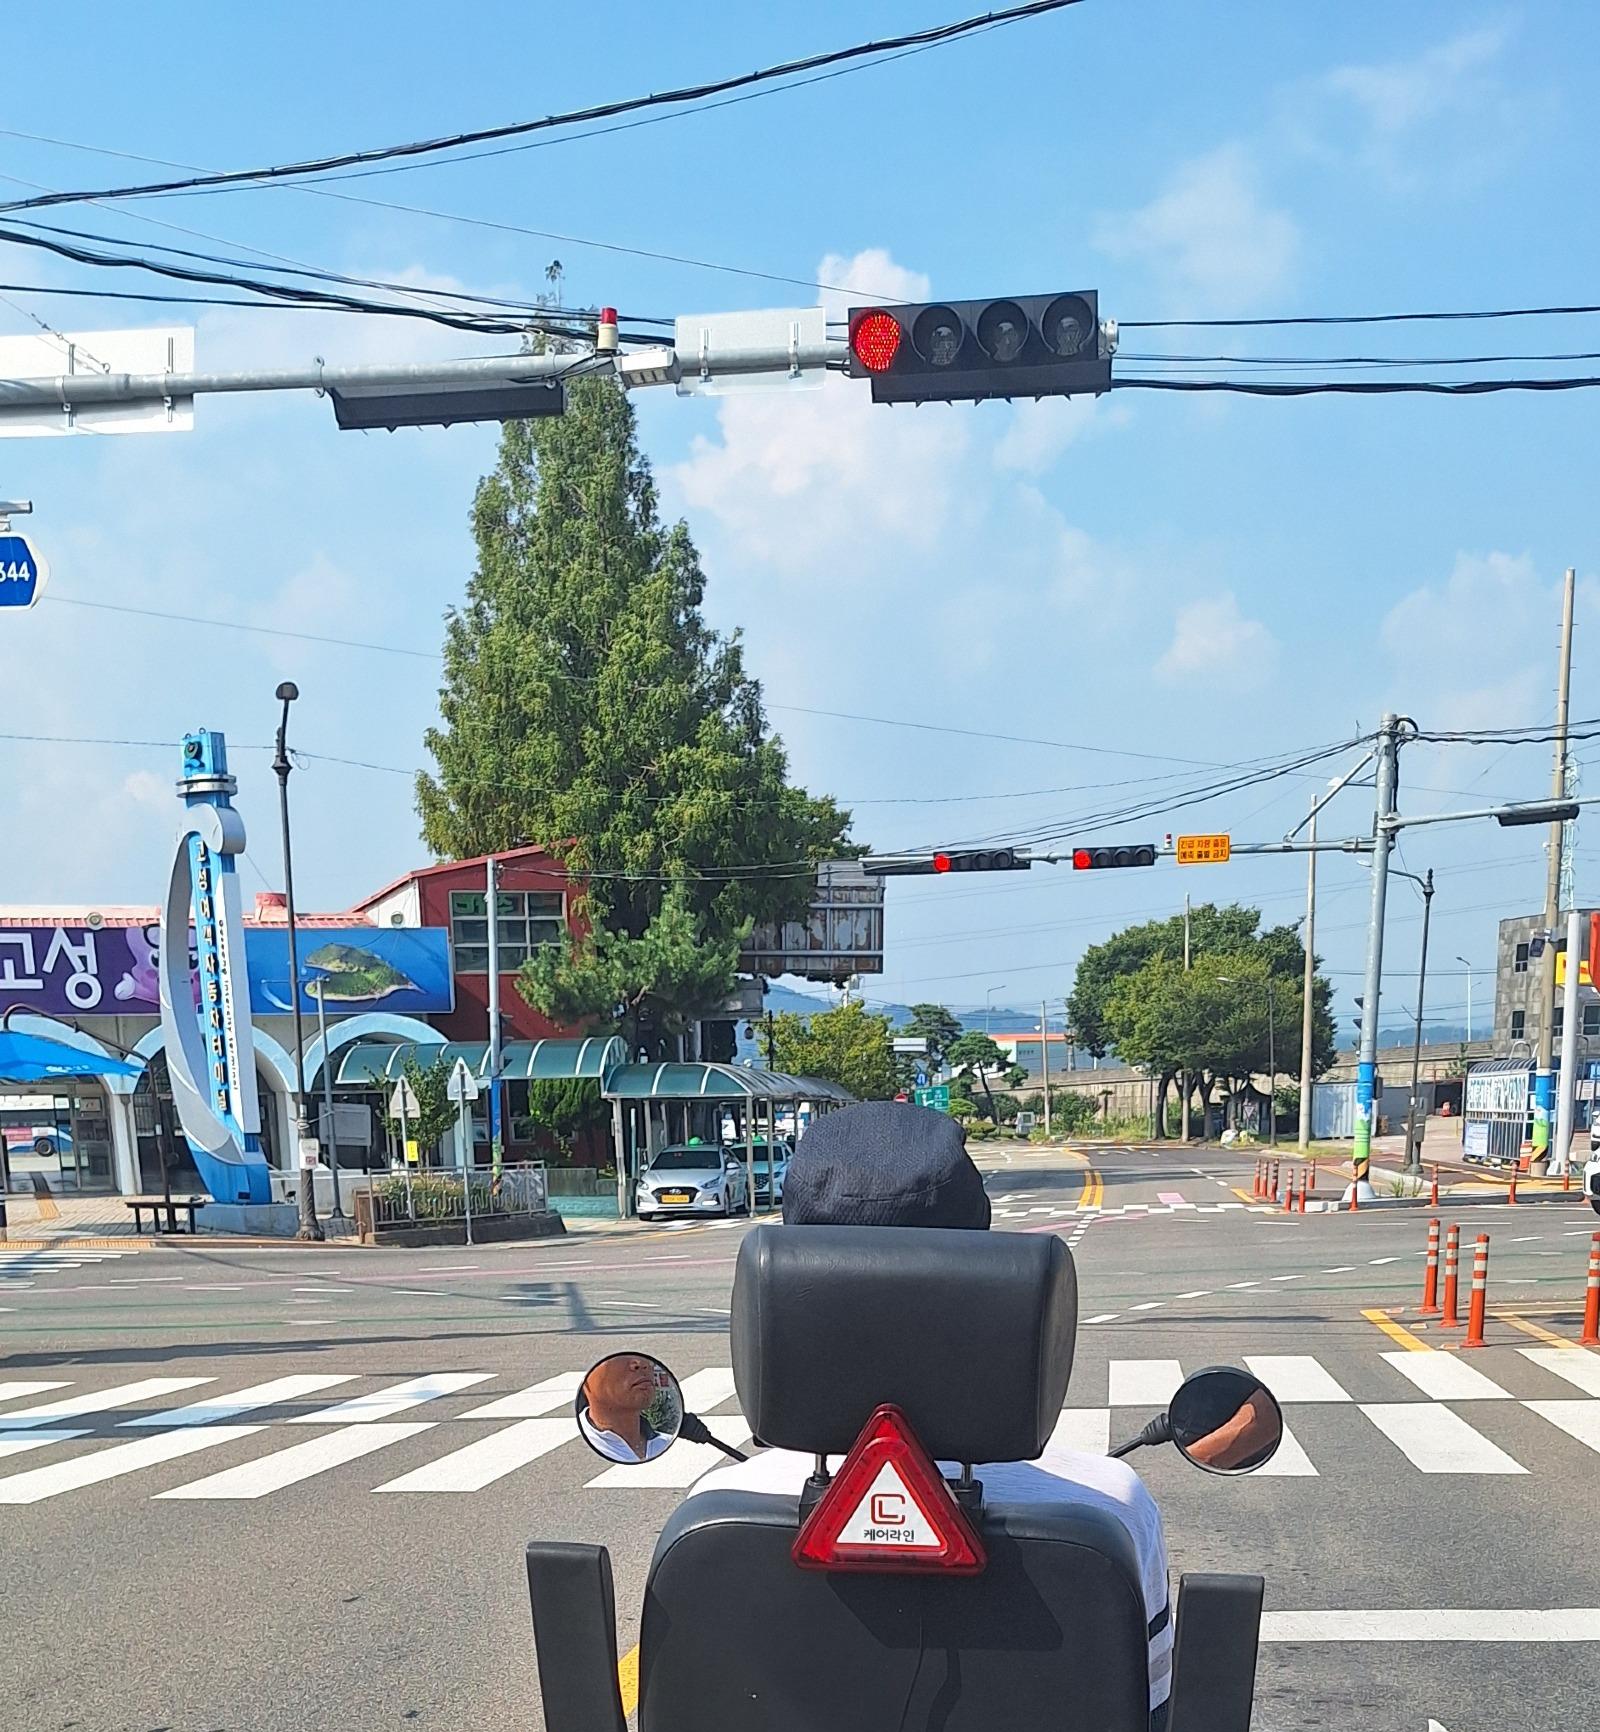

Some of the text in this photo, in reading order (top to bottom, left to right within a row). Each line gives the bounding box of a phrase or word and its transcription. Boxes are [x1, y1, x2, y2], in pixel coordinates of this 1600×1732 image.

[1197, 839, 1210, 848] 차량
[1213, 838, 1227, 848] 출동
[1180, 849, 1227, 859] 예측 출발 금지
[0, 927, 102, 1010] 고성
[863, 1529, 915, 1543] 케어라인
